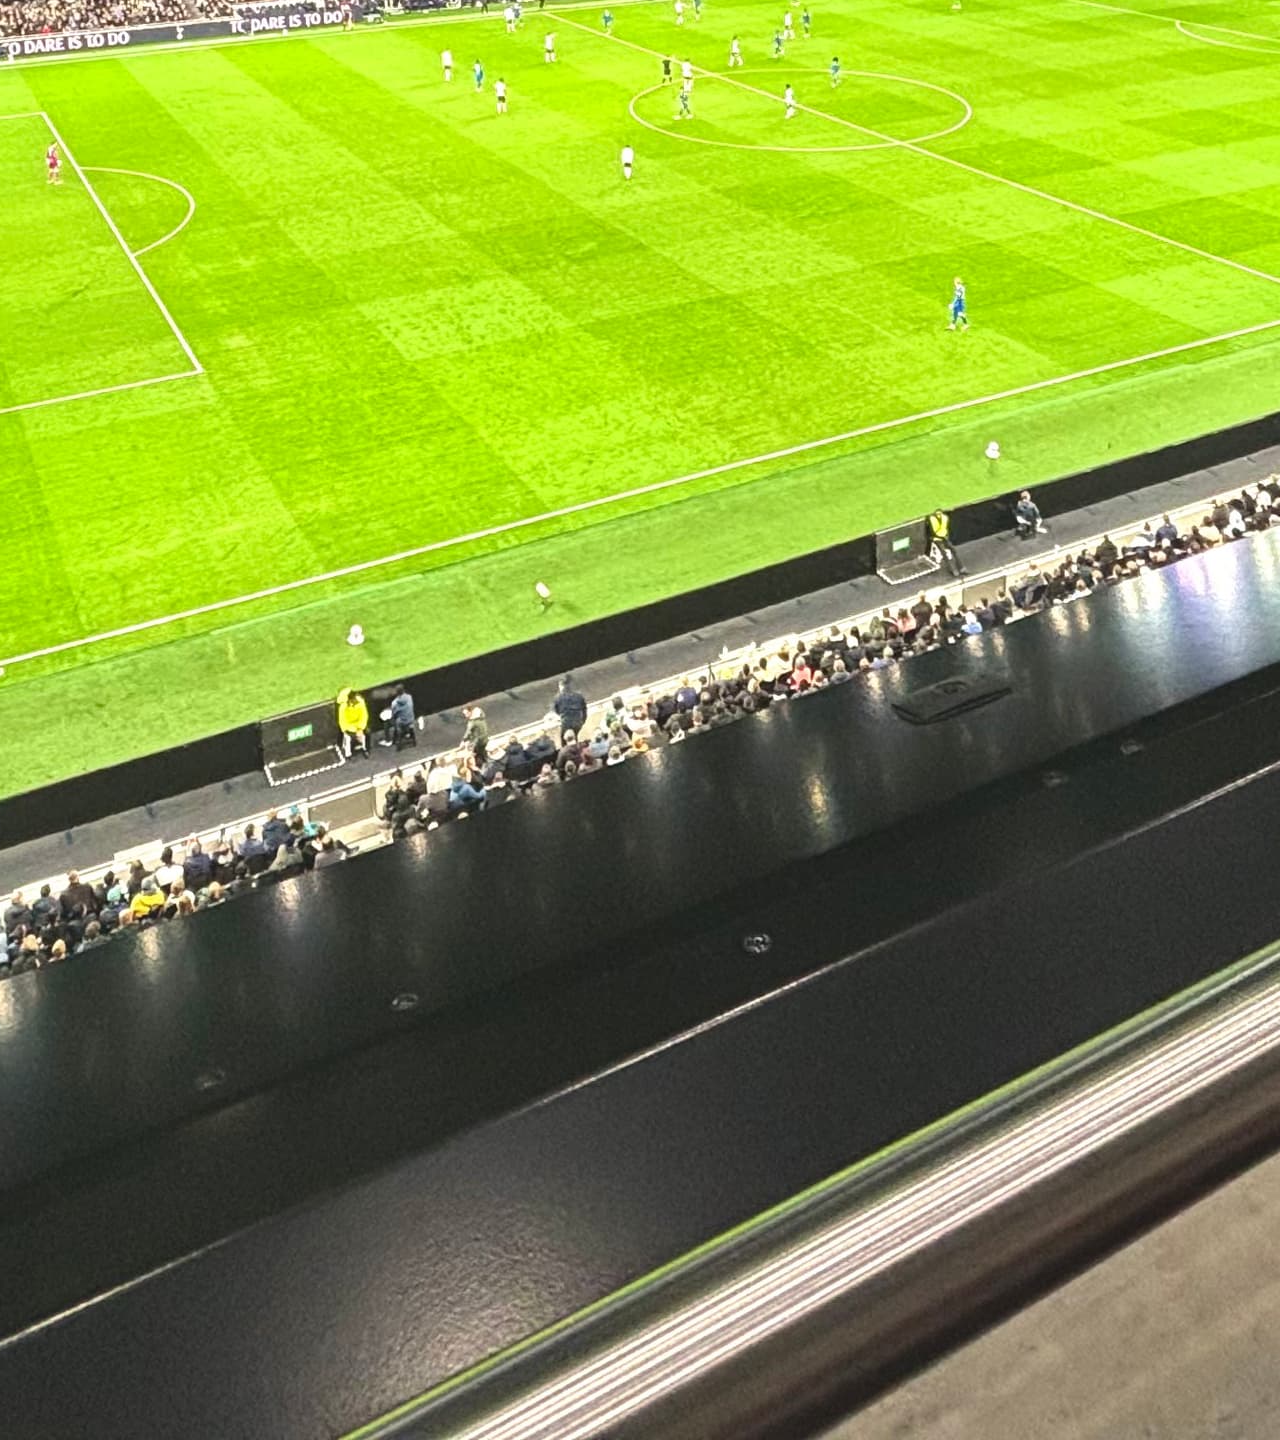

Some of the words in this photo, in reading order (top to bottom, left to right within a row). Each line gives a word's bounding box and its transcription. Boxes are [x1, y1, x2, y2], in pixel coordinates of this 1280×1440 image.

[251, 16, 288, 32] DARE
[289, 15, 302, 28] IS
[304, 12, 322, 27] TO
[323, 10, 343, 24] DO
[24, 37, 64, 54] DARE
[68, 36, 82, 49] IS
[84, 34, 105, 48] TO
[108, 31, 130, 46] DO
